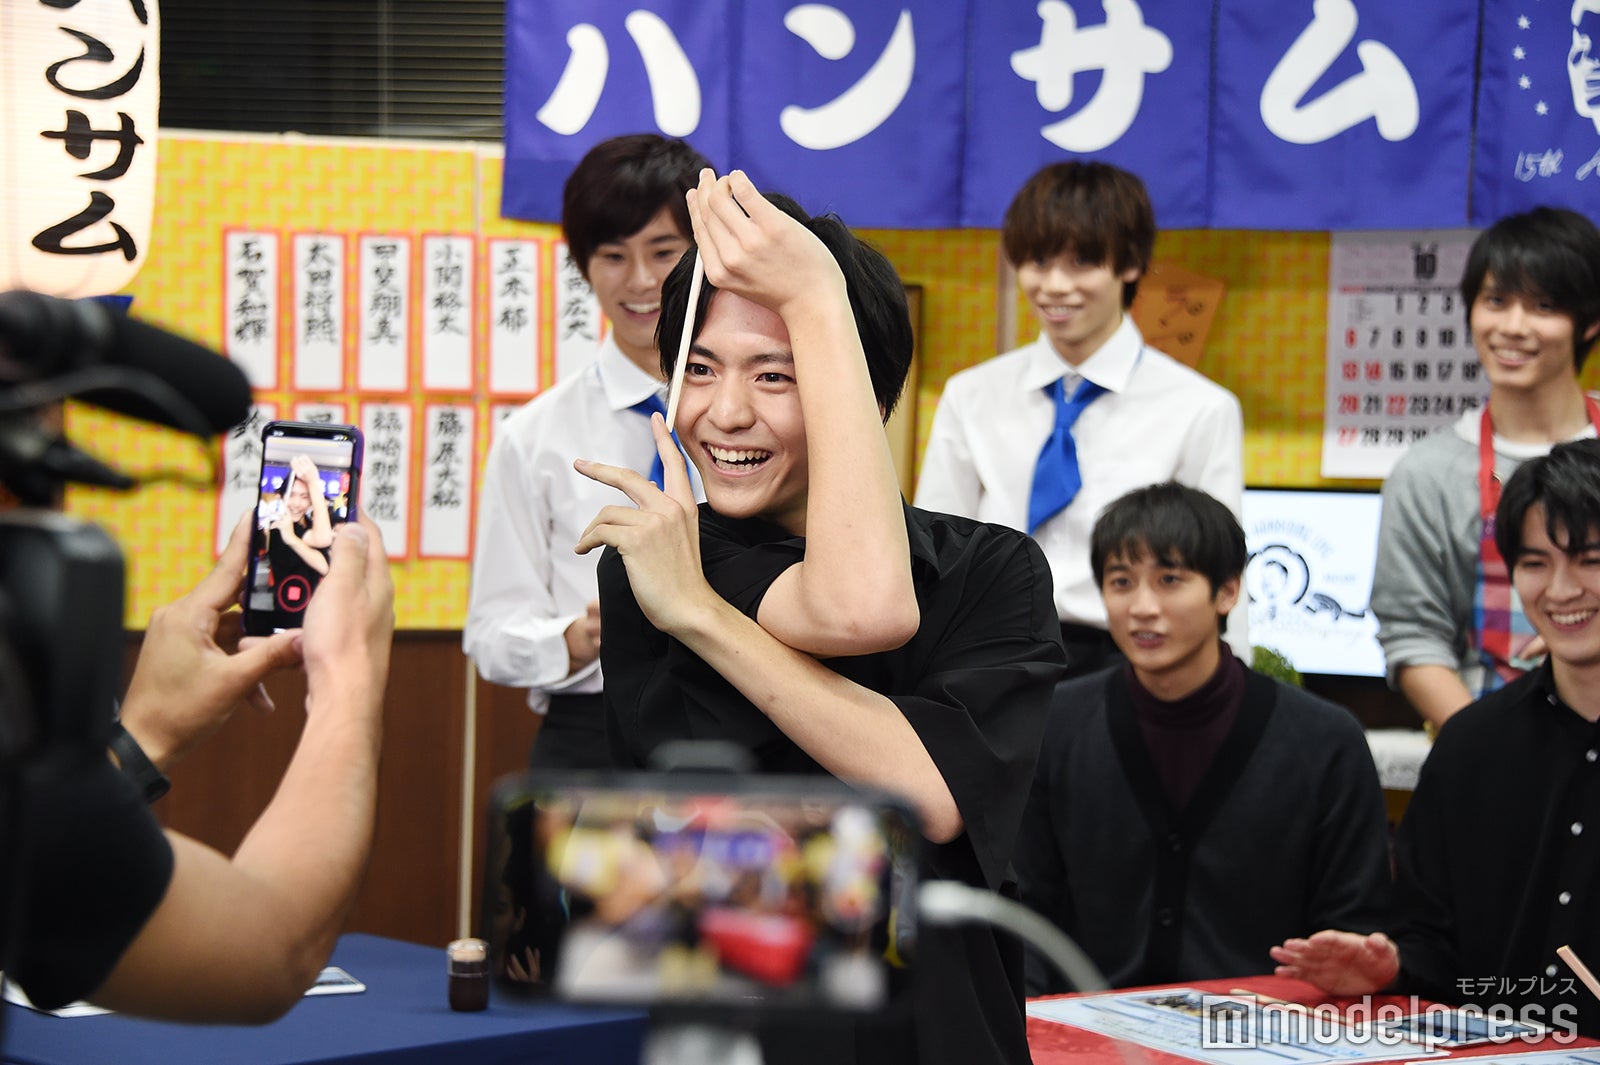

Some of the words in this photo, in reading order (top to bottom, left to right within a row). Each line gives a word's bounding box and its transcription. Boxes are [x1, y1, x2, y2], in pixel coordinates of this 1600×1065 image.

[536, 0, 1420, 153] ハンサム
[1416, 253, 1437, 280] 10
